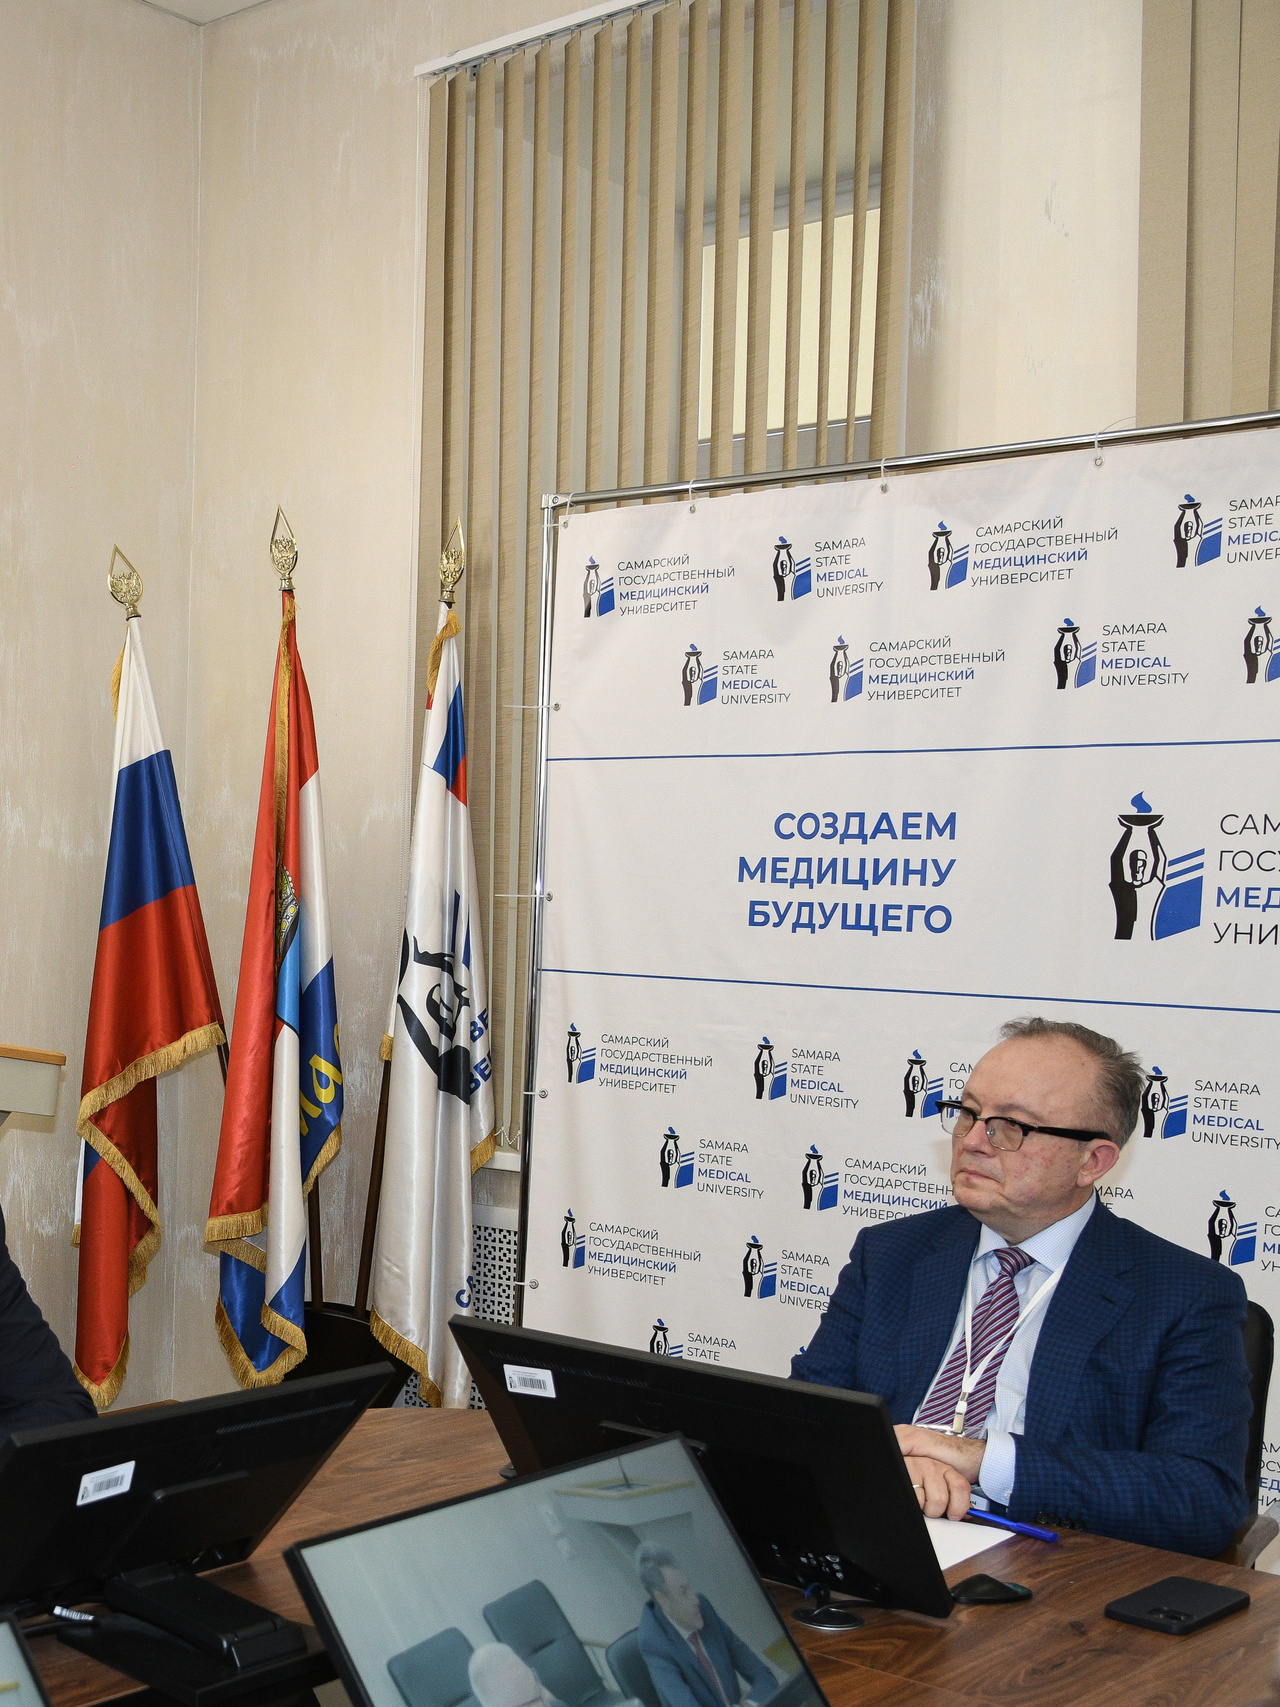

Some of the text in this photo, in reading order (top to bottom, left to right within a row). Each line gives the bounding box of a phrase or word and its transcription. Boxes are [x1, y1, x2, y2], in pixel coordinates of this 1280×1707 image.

[975, 516, 1064, 538] САМАРСКИЙ
[1228, 513, 1274, 529] STATE
[814, 537, 867, 552] SAMARA
[974, 527, 1119, 554] ГОСУДАРСТВЕННЫЙ
[1228, 530, 1280, 546] MEDIC
[617, 553, 690, 571] САМАРСКИЙ
[815, 554, 851, 568] STATE
[972, 548, 1089, 571] МЕДИЦИНСКИЙ
[618, 565, 736, 586] ГОСУДАРСТВЕННЫЙ
[816, 568, 869, 583] MEDICAL
[971, 568, 1074, 588] УНИВЕРСИТЕТ
[619, 582, 710, 602] МЕДИЦИНСКИЙ
[816, 581, 884, 599] UNIVERSITY
[619, 599, 698, 617] УНИВЕРСИТЕТ
[1102, 622, 1168, 636] SAMARA
[869, 635, 952, 653] САМАРСКИЙ
[1101, 640, 1146, 653] STATE
[722, 649, 775, 661] SAMARA
[868, 649, 1005, 671] ГОСУДАРСТВЕННЫЙ
[1101, 656, 1172, 670] MEDICAL
[721, 664, 758, 676] STATE
[868, 668, 975, 687] МЕДИЦИНСКИЙ
[721, 678, 778, 690] MEDICAL
[1100, 672, 1190, 687] UNIVERSITY
[721, 692, 792, 705] UNIVERSITY
[867, 686, 962, 702] УНИВЕРСИТЕТ
[774, 811, 957, 845] СОЗДАЕМ
[737, 856, 957, 891] МЕДИЦИНУ
[748, 900, 953, 936] БУДУЩЕГО
[601, 1033, 670, 1049] САМАРСКИЙ
[600, 1048, 713, 1067] ГОСУДАРСТВЕННЫЙ
[791, 1048, 841, 1062] SAMARA
[599, 1063, 688, 1080] МЕДИЦИНСКИЙ
[790, 1063, 824, 1076] STATE
[598, 1077, 677, 1094] УНИВЕРСИТЕТ
[790, 1078, 844, 1093] MEDICAL
[1194, 1079, 1261, 1096] SAMARA
[789, 1093, 859, 1110] UNIVERSITY
[1193, 1096, 1239, 1112] STATE
[1192, 1114, 1265, 1131] MEDICAL
[699, 1138, 749, 1153] SAMARA
[1191, 1131, 1280, 1151] UNIVERSITY
[698, 1153, 732, 1167] STATE
[844, 1157, 927, 1177] САМАРСКИЙ
[697, 1168, 751, 1183] MEDICAL
[696, 1182, 764, 1200] UNIVERSITY
[843, 1189, 948, 1209] МЕДИЦИНСКИЙ
[589, 1221, 659, 1241] САМАРСКИЙ
[588, 1236, 702, 1263] ГОСУДАРСТВЕННЫЙ
[781, 1249, 830, 1267] SAMARA
[587, 1250, 677, 1274] МЕДИЦИНСКИЙ
[587, 1265, 666, 1286] УНИВЕРСИТЕТ
[780, 1264, 813, 1279] STATE
[779, 1279, 832, 1297] MEDICAL
[687, 1332, 737, 1350] SAMARA
[686, 1346, 721, 1362] STATE
